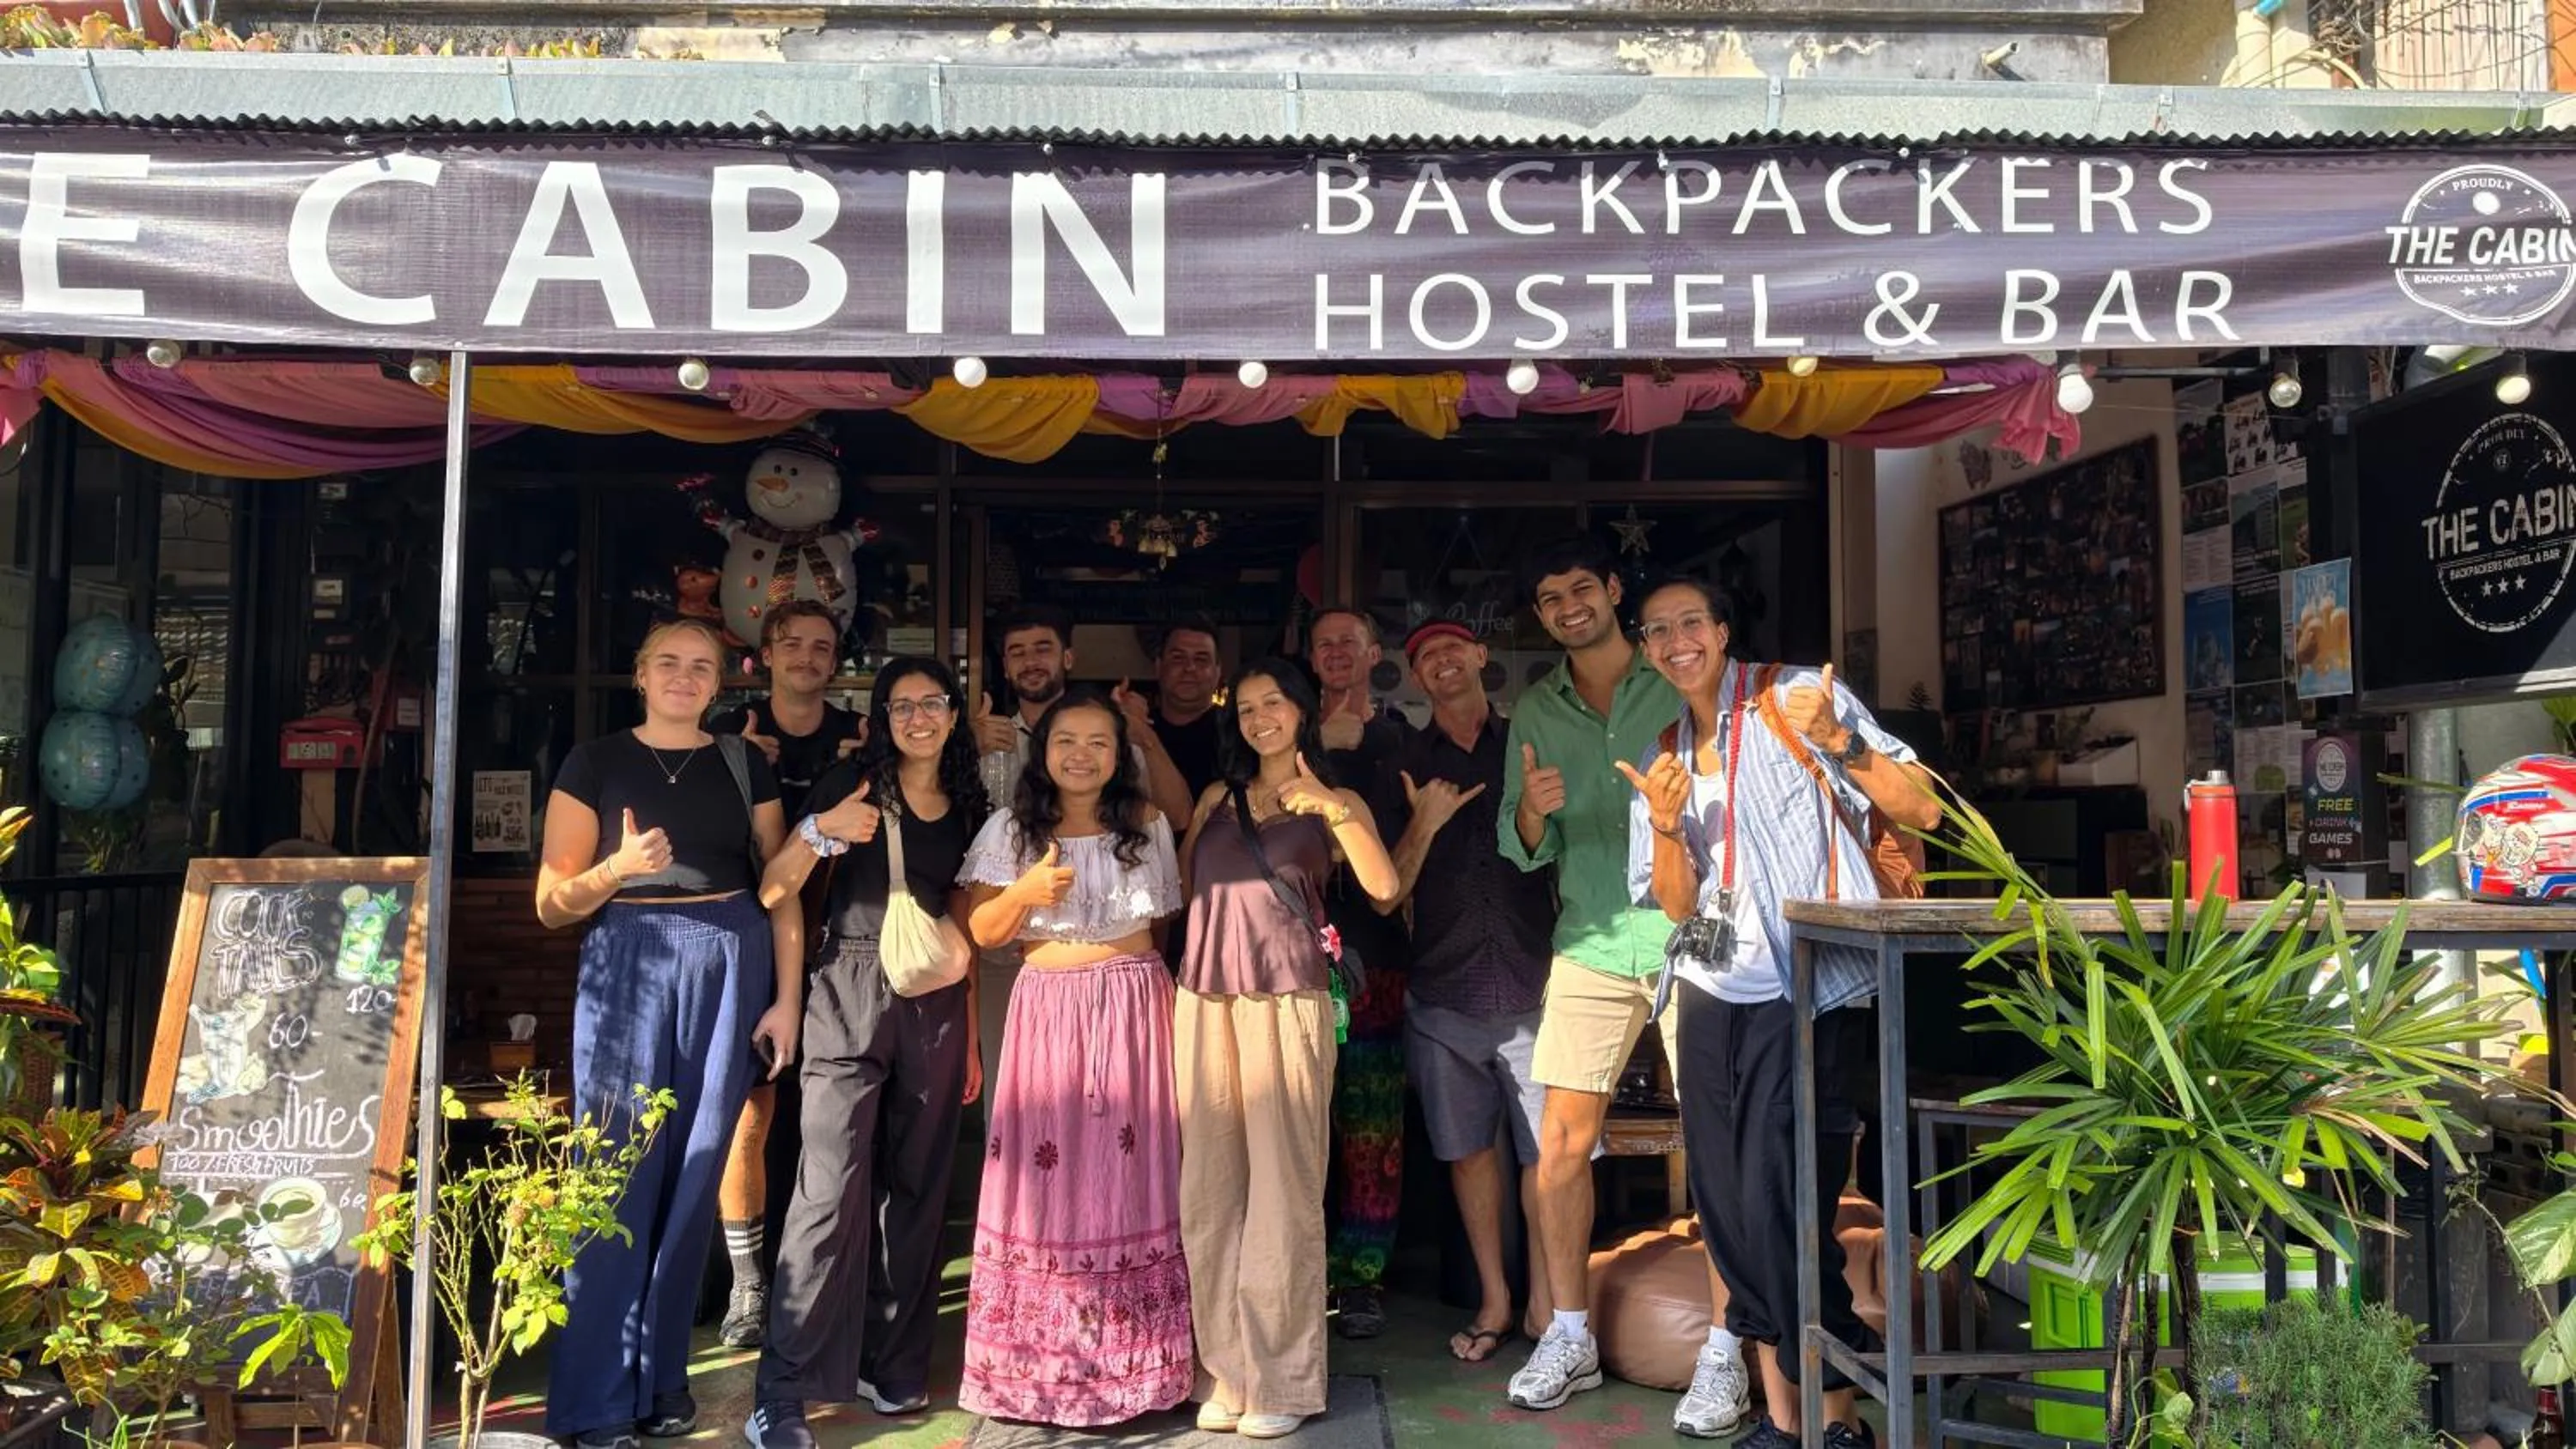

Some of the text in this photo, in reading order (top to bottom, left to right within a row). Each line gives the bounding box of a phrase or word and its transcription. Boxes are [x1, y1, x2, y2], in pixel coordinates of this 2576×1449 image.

[1315, 157, 2215, 235] BACKPACKERS
[2451, 178, 2513, 191] PROUDLY
[287, 151, 1165, 336] CABIN
[2385, 226, 2459, 264] THE
[2414, 272, 2482, 284] BACKPACKERS
[2484, 271, 2524, 282] HOSTEL
[2535, 270, 2557, 279] BAR
[1314, 269, 2242, 351] HOSTEL & BAR
[2421, 506, 2479, 561] THE
[2450, 560, 2502, 580] BACKPACKERS
[2503, 555, 2534, 572] HOSTEL
[2543, 548, 2561, 563] BAR
[2318, 797, 2354, 811] FREE
[2309, 833, 2353, 845] GAMES
